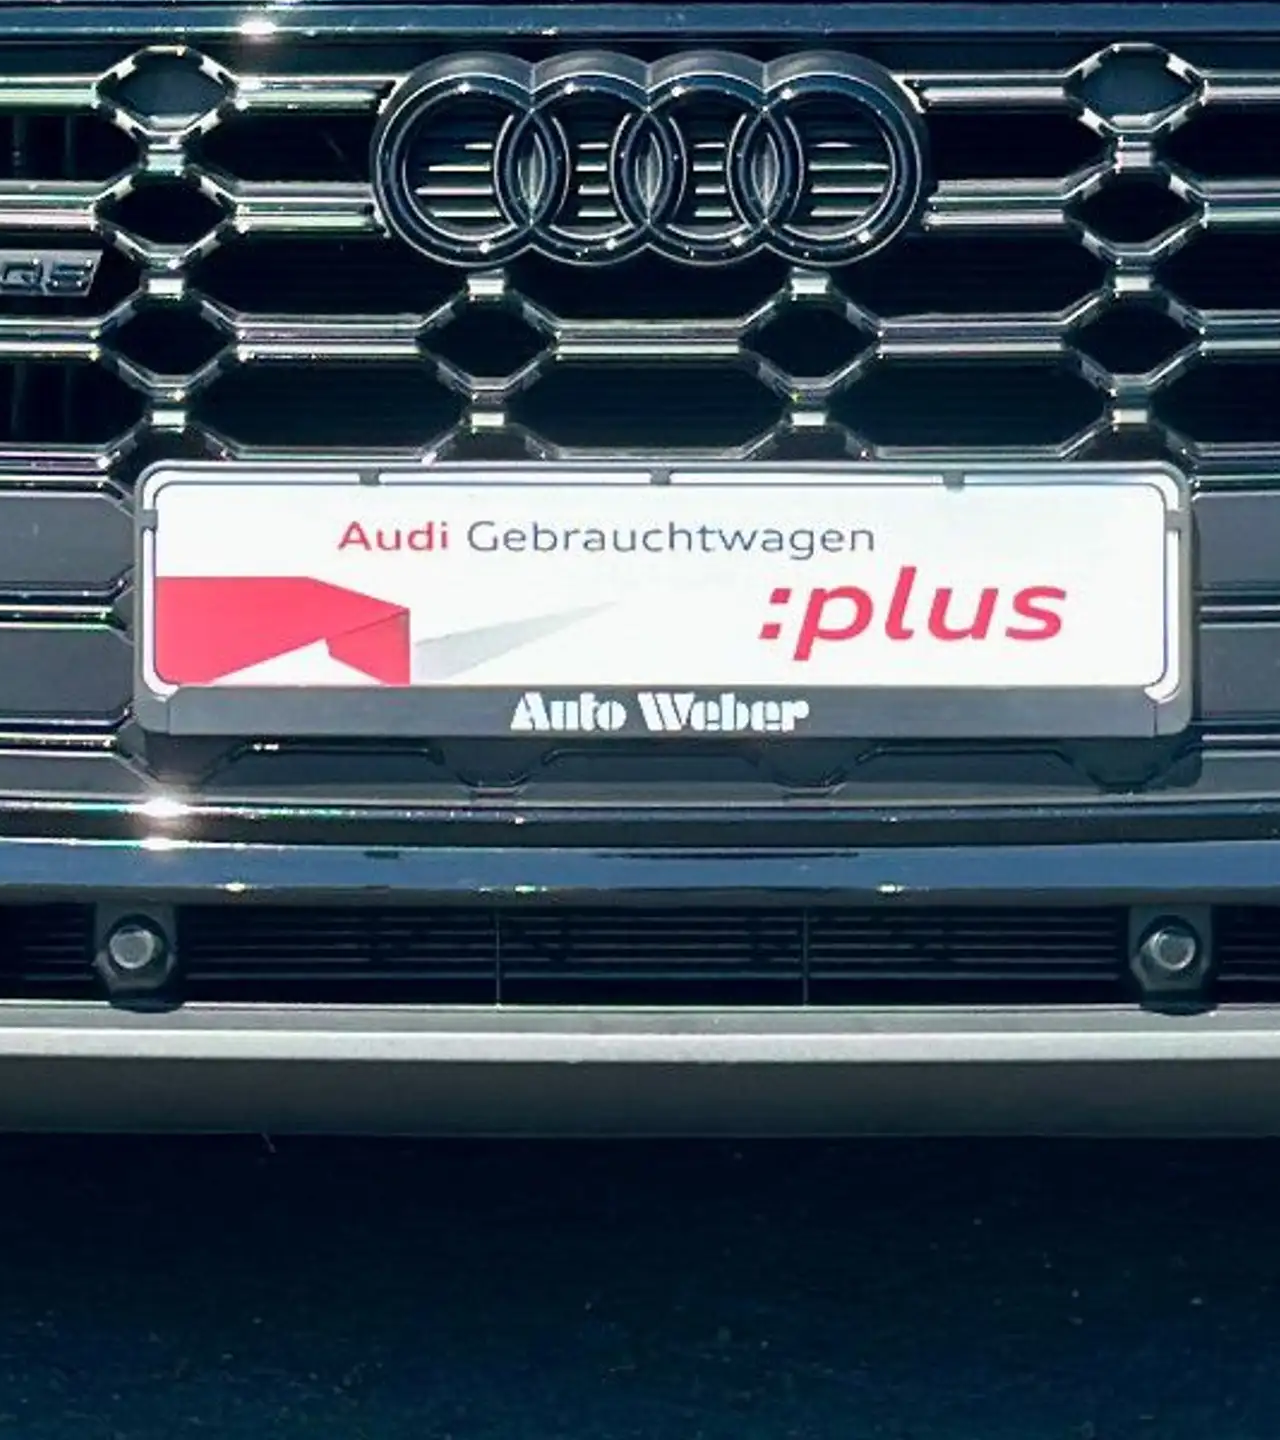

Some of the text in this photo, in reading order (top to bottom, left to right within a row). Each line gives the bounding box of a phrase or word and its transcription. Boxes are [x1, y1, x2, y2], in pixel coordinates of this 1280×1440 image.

[337, 521, 875, 561] Audi Gebrauchtwagen
[758, 565, 1067, 662] :plus
[510, 691, 810, 733] Auto Weber
